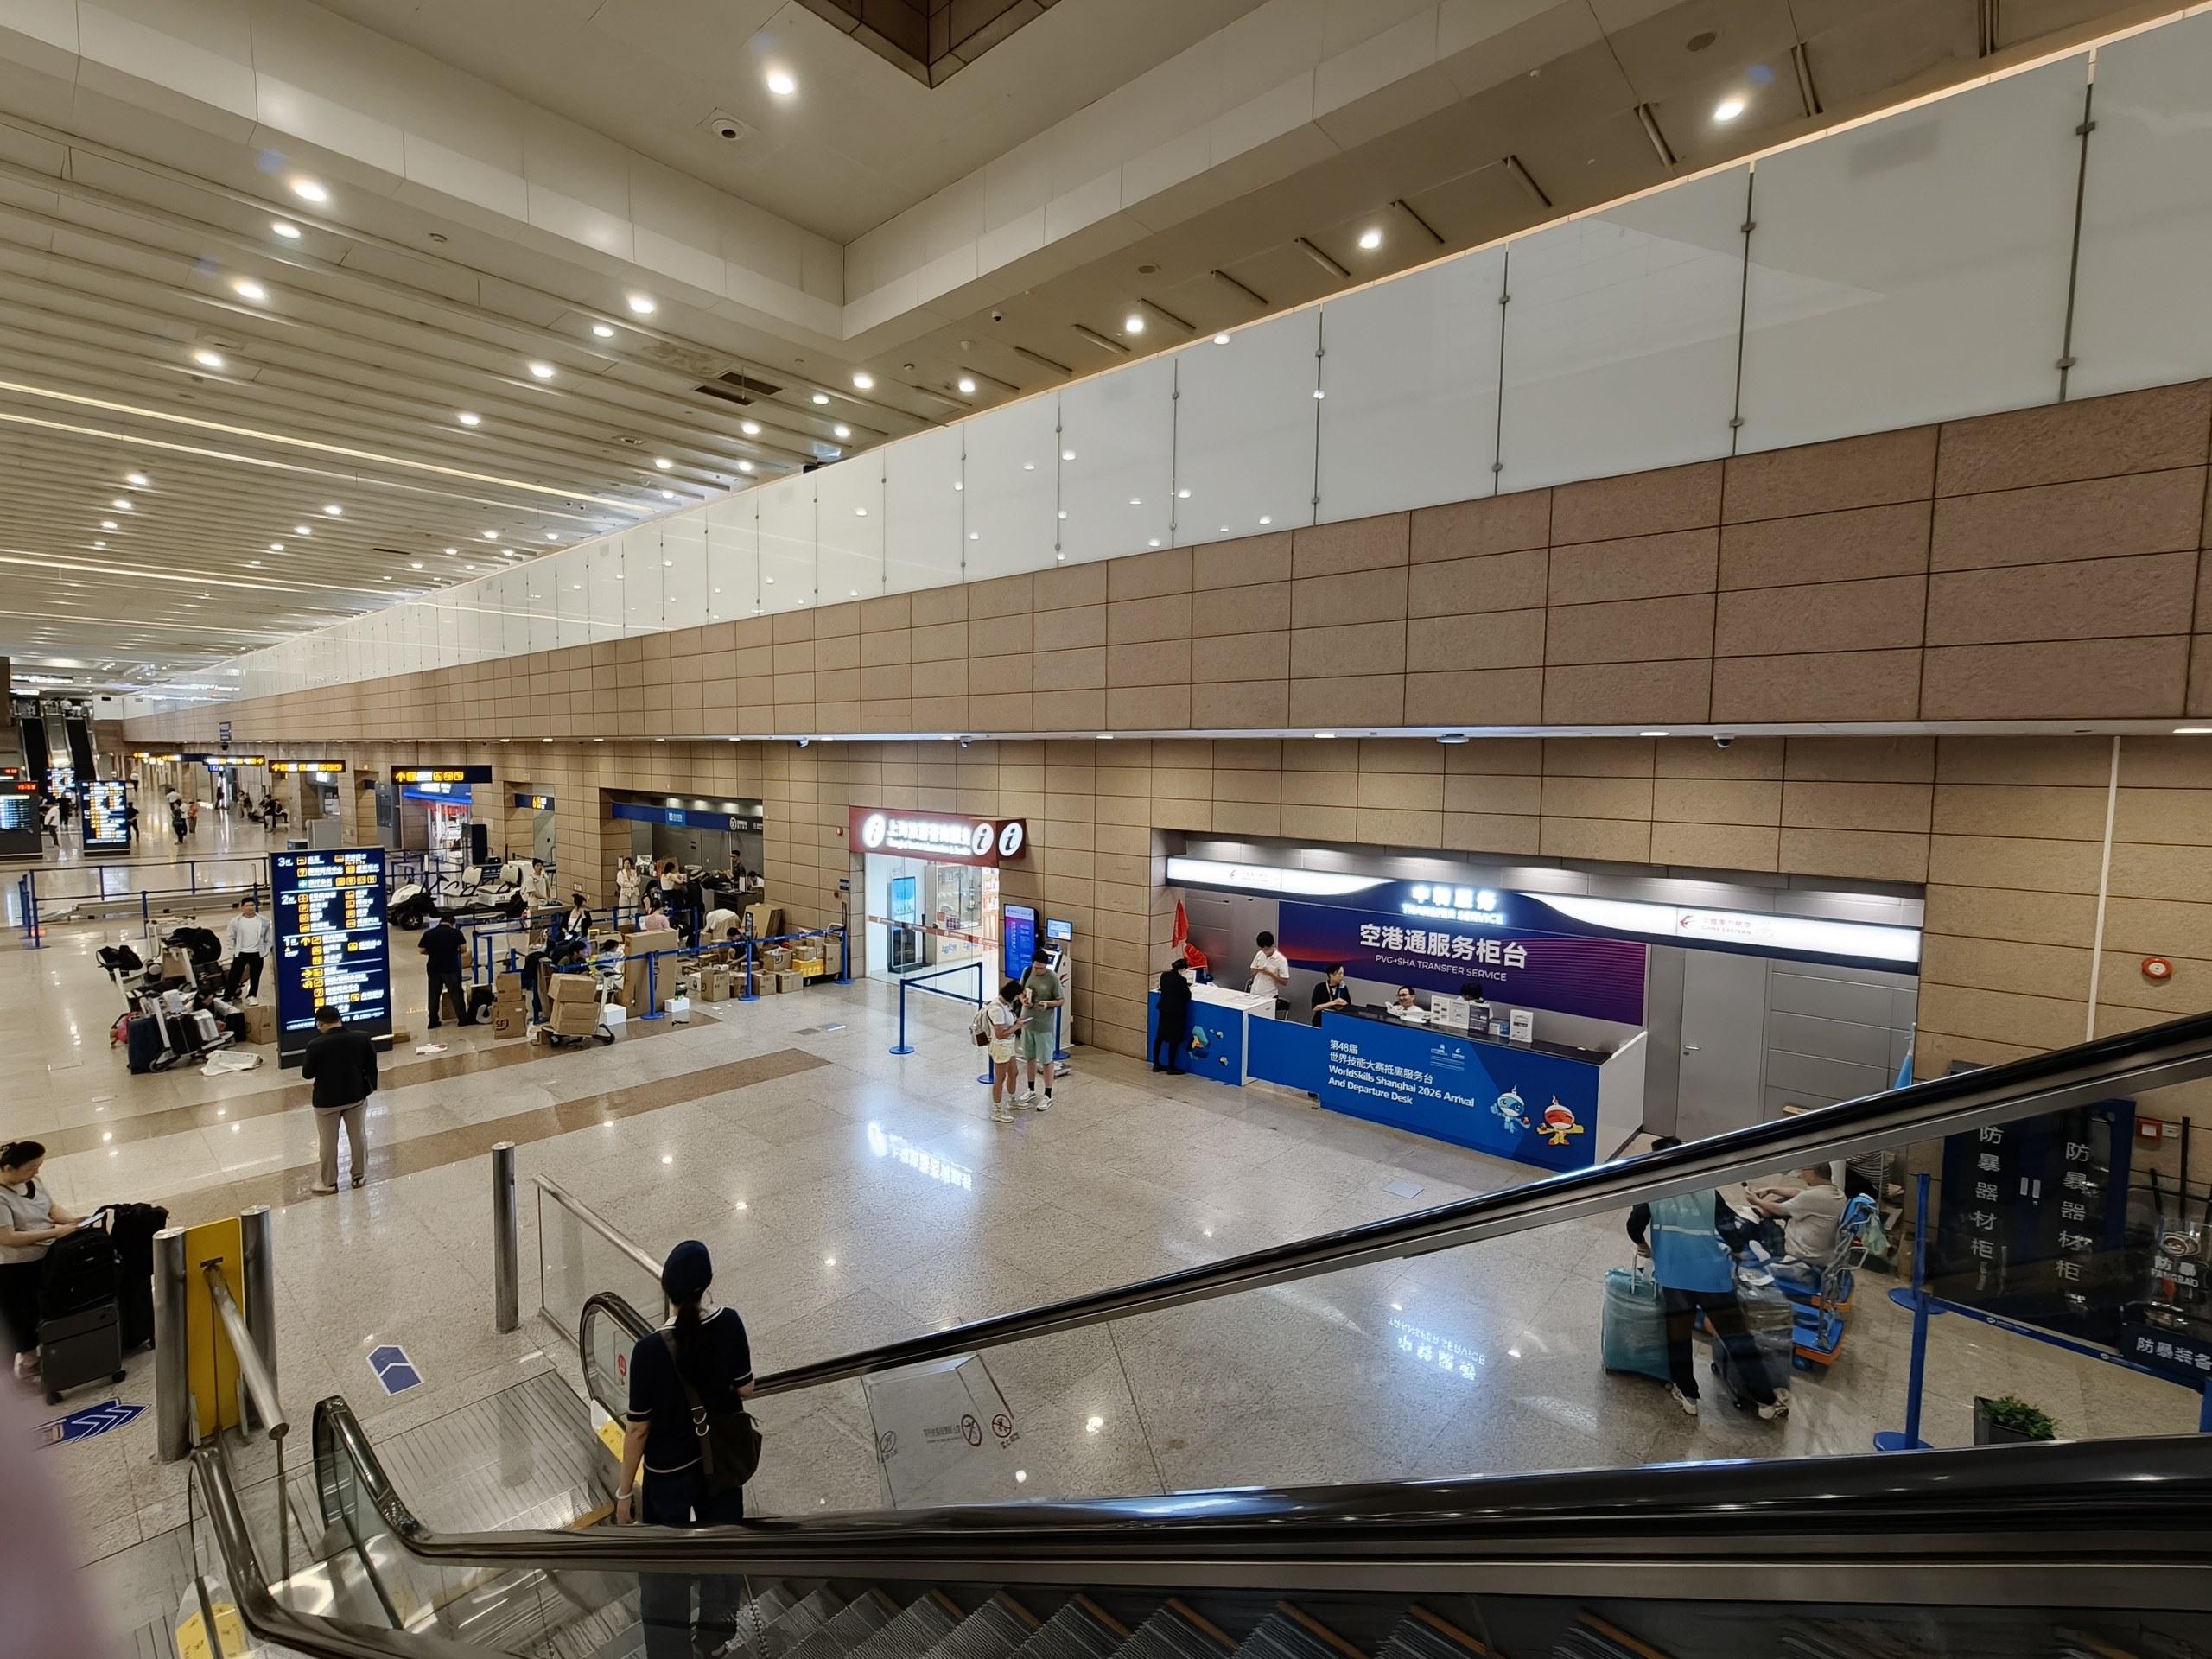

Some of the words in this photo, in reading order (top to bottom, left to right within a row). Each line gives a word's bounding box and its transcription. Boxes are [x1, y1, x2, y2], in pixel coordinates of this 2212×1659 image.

[1401, 903, 1457, 921] TRANSFER
[1457, 910, 1505, 925] SERVICE
[1360, 923, 1528, 969] 空港通服务柜台
[1417, 960, 1465, 976] TRANSFER
[1466, 968, 1507, 982] SERVICE
[1330, 1039, 1358, 1055] 第48届
[1329, 1052, 1433, 1084] 世界技能大赛抵离服务台
[1328, 1064, 1375, 1083] WorldSkills
[1376, 1075, 1416, 1094] Shanghai
[1418, 1085, 1442, 1099] 2026
[1443, 1091, 1475, 1108] Arrival
[1328, 1077, 1345, 1088] And
[1347, 1081, 1389, 1099] Departure
[1391, 1092, 1413, 1105] Desk
[1970, 1126, 2005, 1260] 防暴器材柜
[2055, 1141, 2091, 1281] 防暴器材柜
